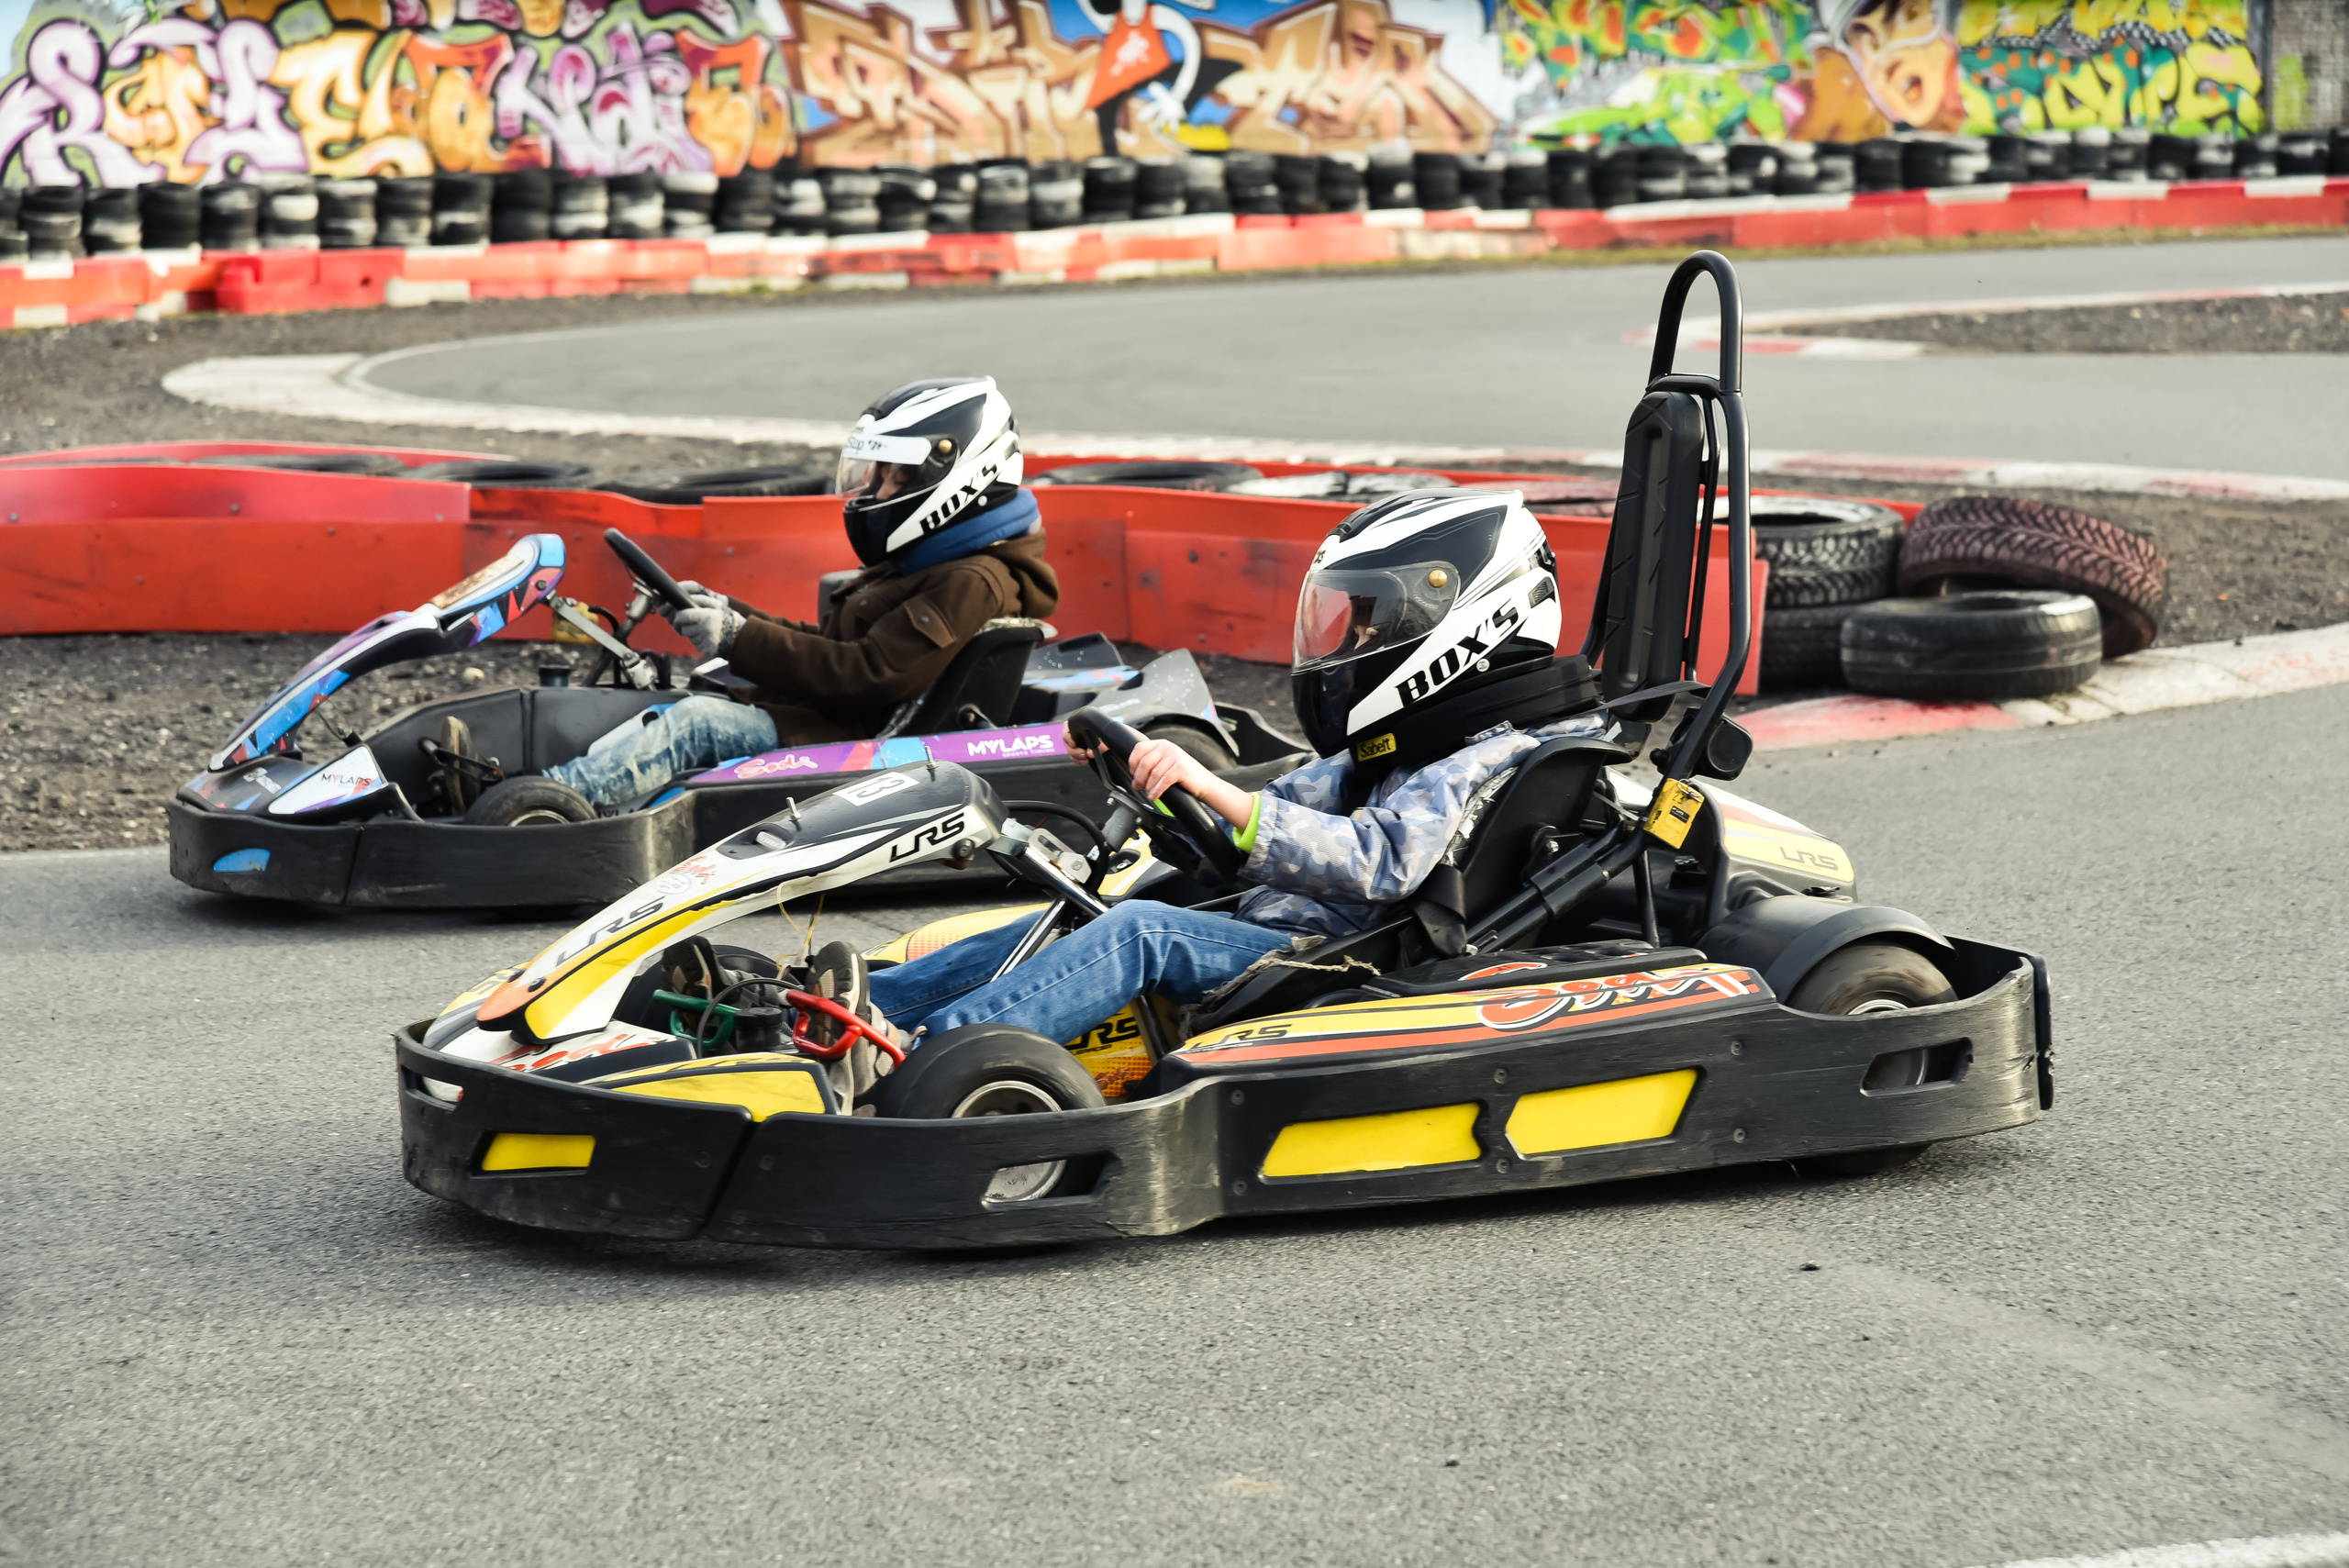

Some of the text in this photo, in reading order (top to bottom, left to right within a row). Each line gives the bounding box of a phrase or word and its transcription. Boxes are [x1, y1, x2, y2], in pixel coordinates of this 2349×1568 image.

[919, 462, 998, 536] BOX'S
[1395, 596, 1520, 708] BOX'S
[967, 734, 1054, 756] MYLAPS
[1360, 738, 1391, 758] Sabelt
[734, 754, 818, 779] Sodi
[321, 773, 371, 786] MYLAPS
[889, 812, 964, 862] LRS
[1779, 846, 1839, 871] LRS
[556, 895, 666, 967] LRS
[1190, 1024, 1293, 1050] LRS
